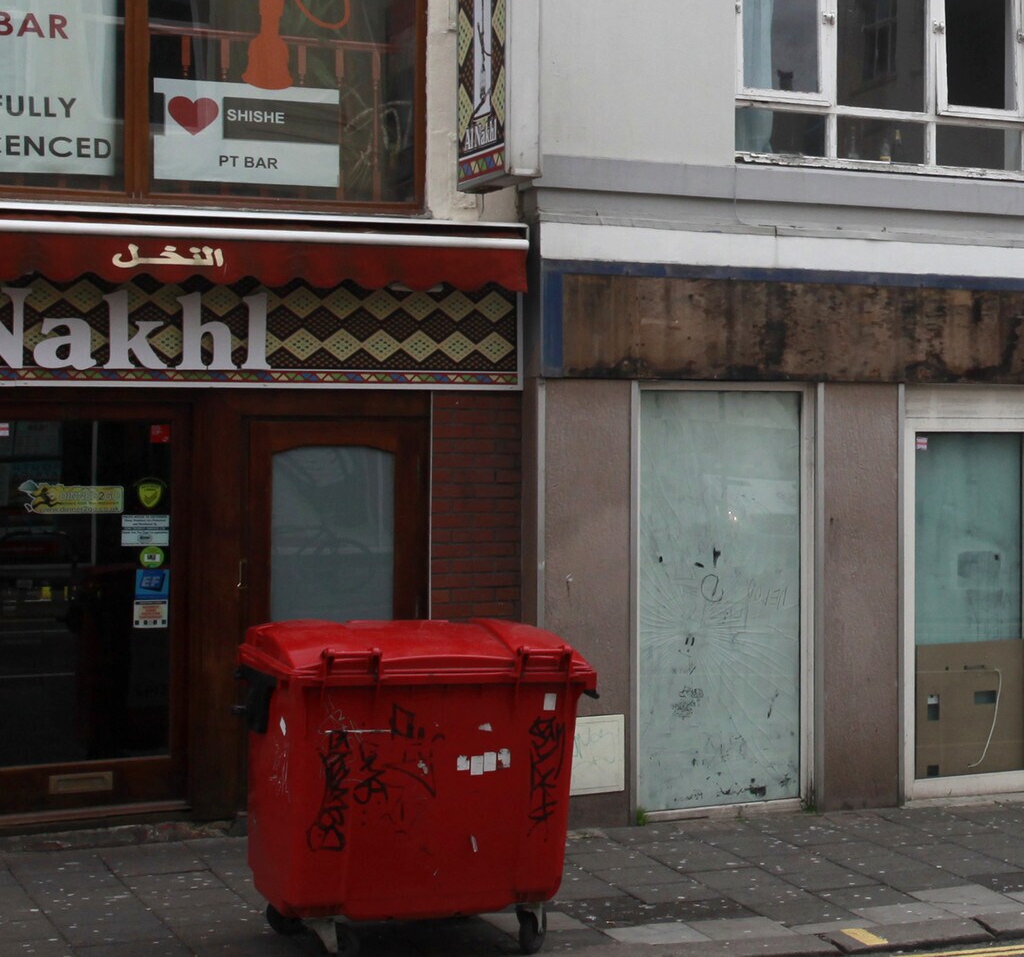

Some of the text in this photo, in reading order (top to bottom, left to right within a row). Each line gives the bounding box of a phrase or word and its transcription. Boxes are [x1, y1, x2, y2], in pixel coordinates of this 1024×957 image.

[0, 11, 69, 39] BAR
[0, 95, 77, 119] ULLY
[226, 108, 286, 125] SHISHE
[474, 118, 498, 148] Nakhl
[0, 134, 112, 160] ENCED
[218, 154, 279, 170] PT BAR
[111, 242, 225, 269] النخل
